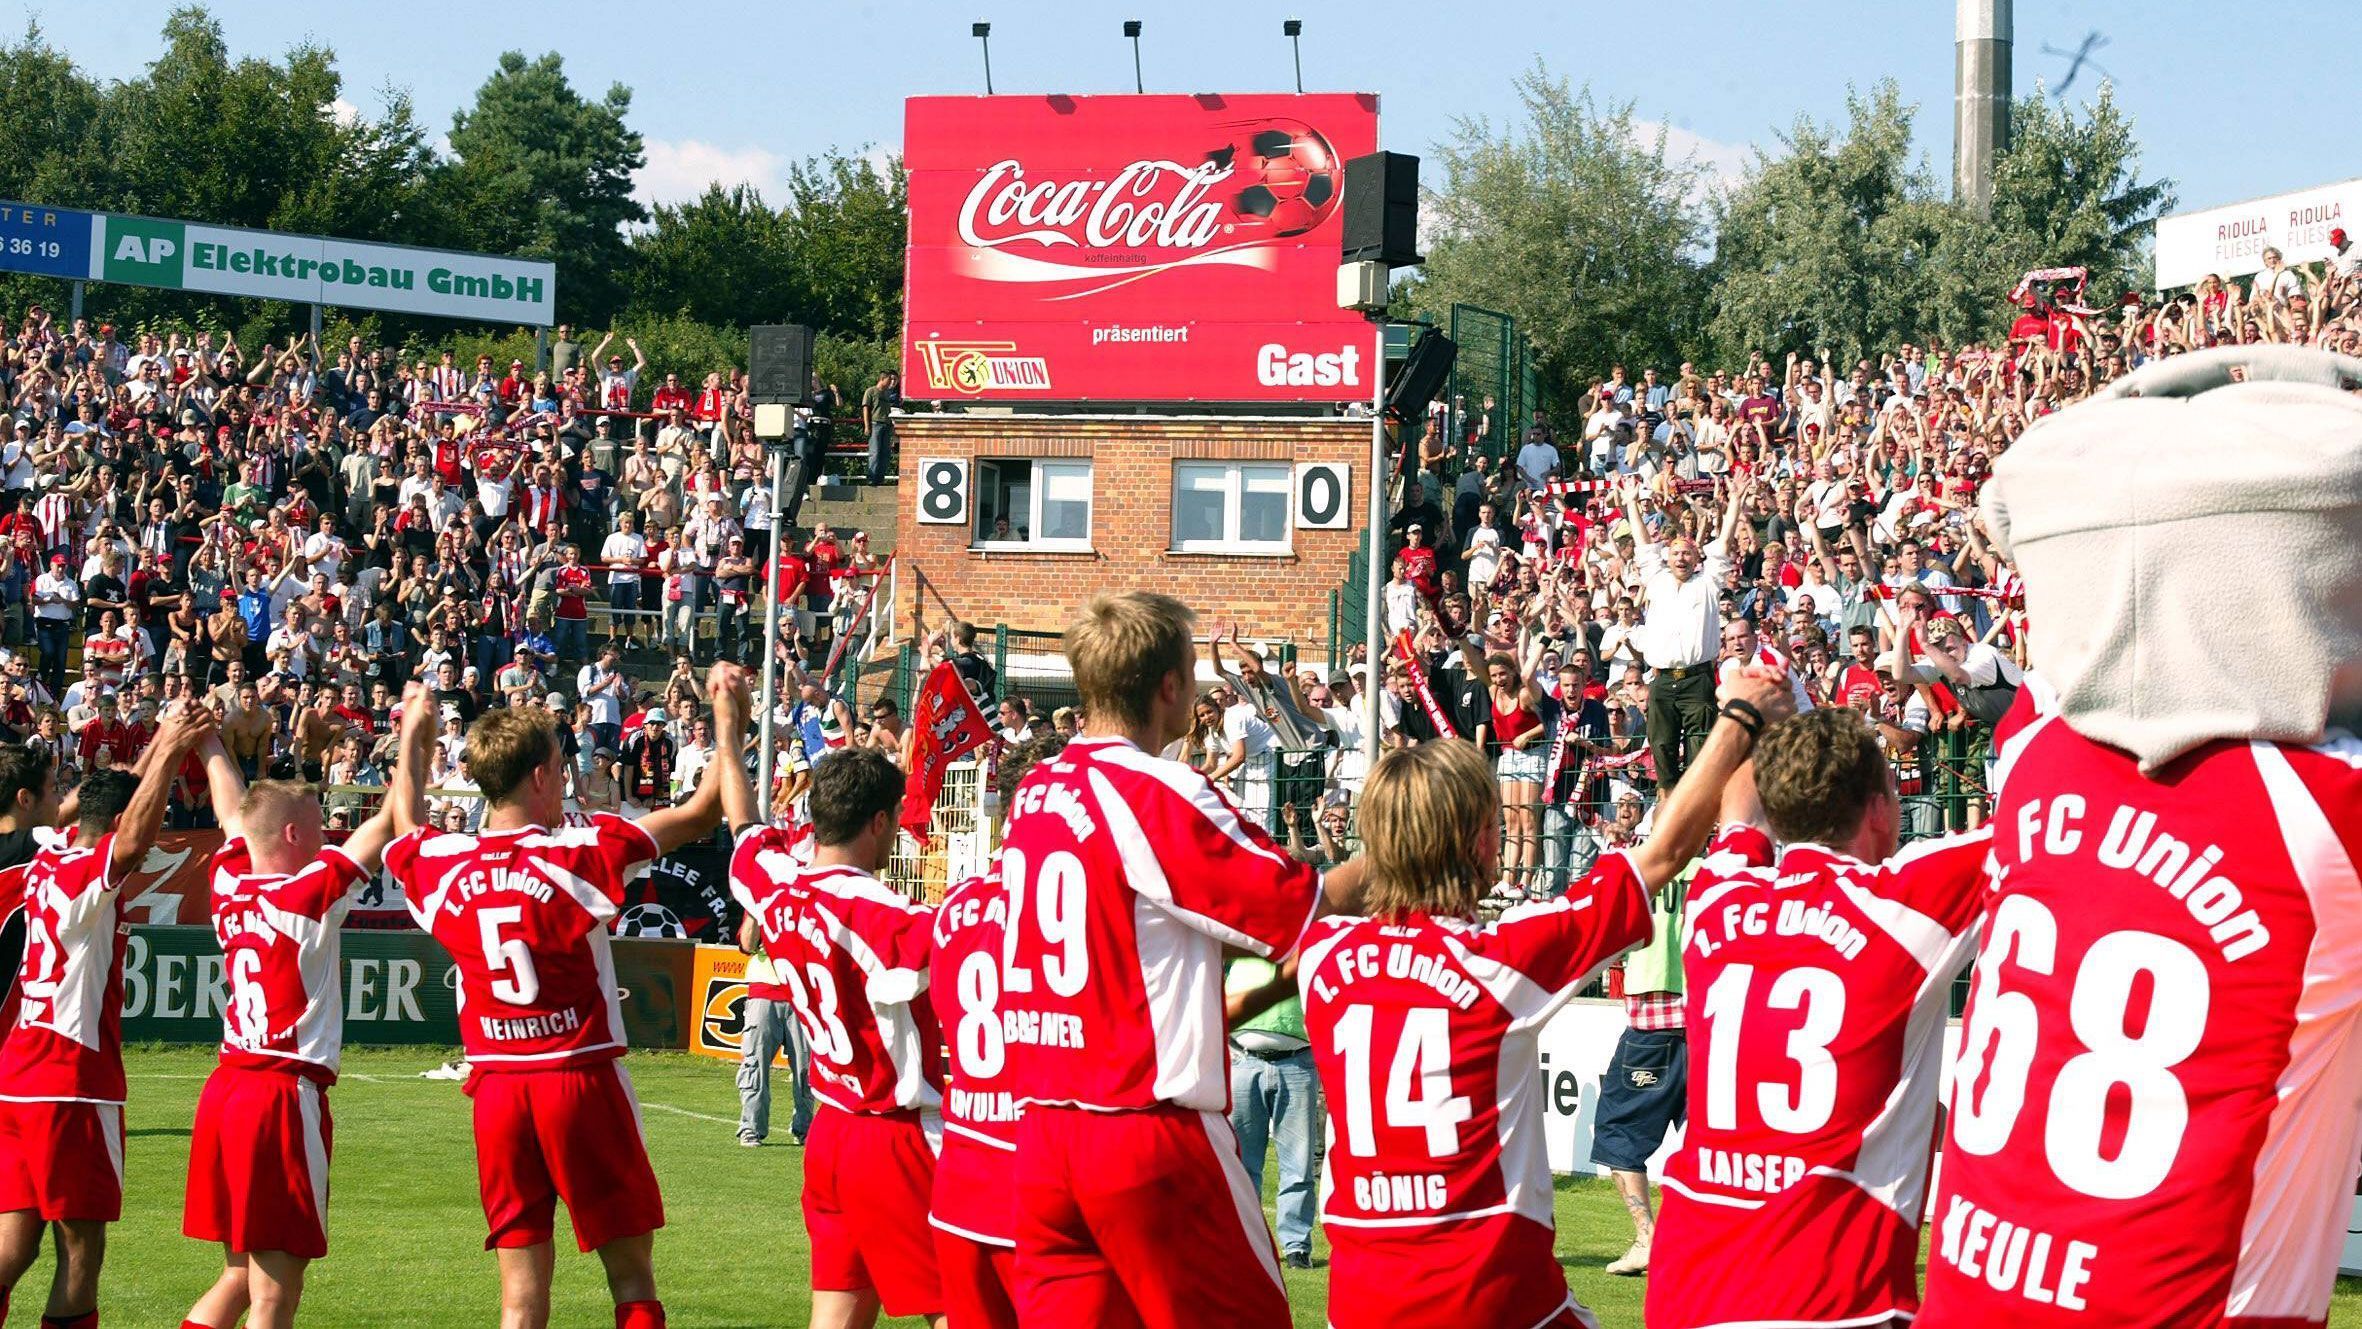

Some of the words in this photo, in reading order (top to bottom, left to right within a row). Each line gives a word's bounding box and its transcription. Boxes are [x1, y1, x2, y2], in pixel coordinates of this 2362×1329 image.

[958, 159, 1234, 248] Coca-Cola
[2218, 217, 2267, 241] RIDULA
[2290, 202, 2341, 228] RIDULA
[10, 238, 32, 255] 36
[39, 241, 60, 258] 19
[114, 235, 176, 265] AP
[192, 242, 415, 290] Elektrobau
[426, 266, 544, 304] GmbH
[1085, 253, 1147, 264] koffeinhaltig
[1092, 324, 1188, 346] präsentiert
[991, 361, 1046, 385] UNION
[1256, 343, 1360, 388] Gast
[922, 462, 962, 519] 8
[1302, 466, 1341, 524] 0
[1013, 784, 1047, 820] FC
[445, 898, 465, 917] 1.
[459, 874, 487, 903] FC
[491, 867, 555, 904] Union
[2017, 793, 2087, 864] FC
[2096, 804, 2271, 963] Union
[1001, 847, 1090, 997] 29
[1694, 928, 1722, 958] 1.
[1723, 902, 1770, 942] FC
[1775, 900, 1868, 961] Union
[476, 905, 540, 1005] 5
[1312, 973, 1340, 1004] 1.
[1339, 946, 1380, 981] FC
[1386, 944, 1481, 1011] Union
[480, 1007, 580, 1041] HEINRICH
[956, 950, 1006, 1079] 8
[1702, 962, 1847, 1134] 13
[1952, 894, 2211, 1200] 68
[1332, 1003, 1472, 1159] 14
[1353, 1169, 1448, 1213] BÖNIG
[1941, 1194, 2098, 1312] KEULE
